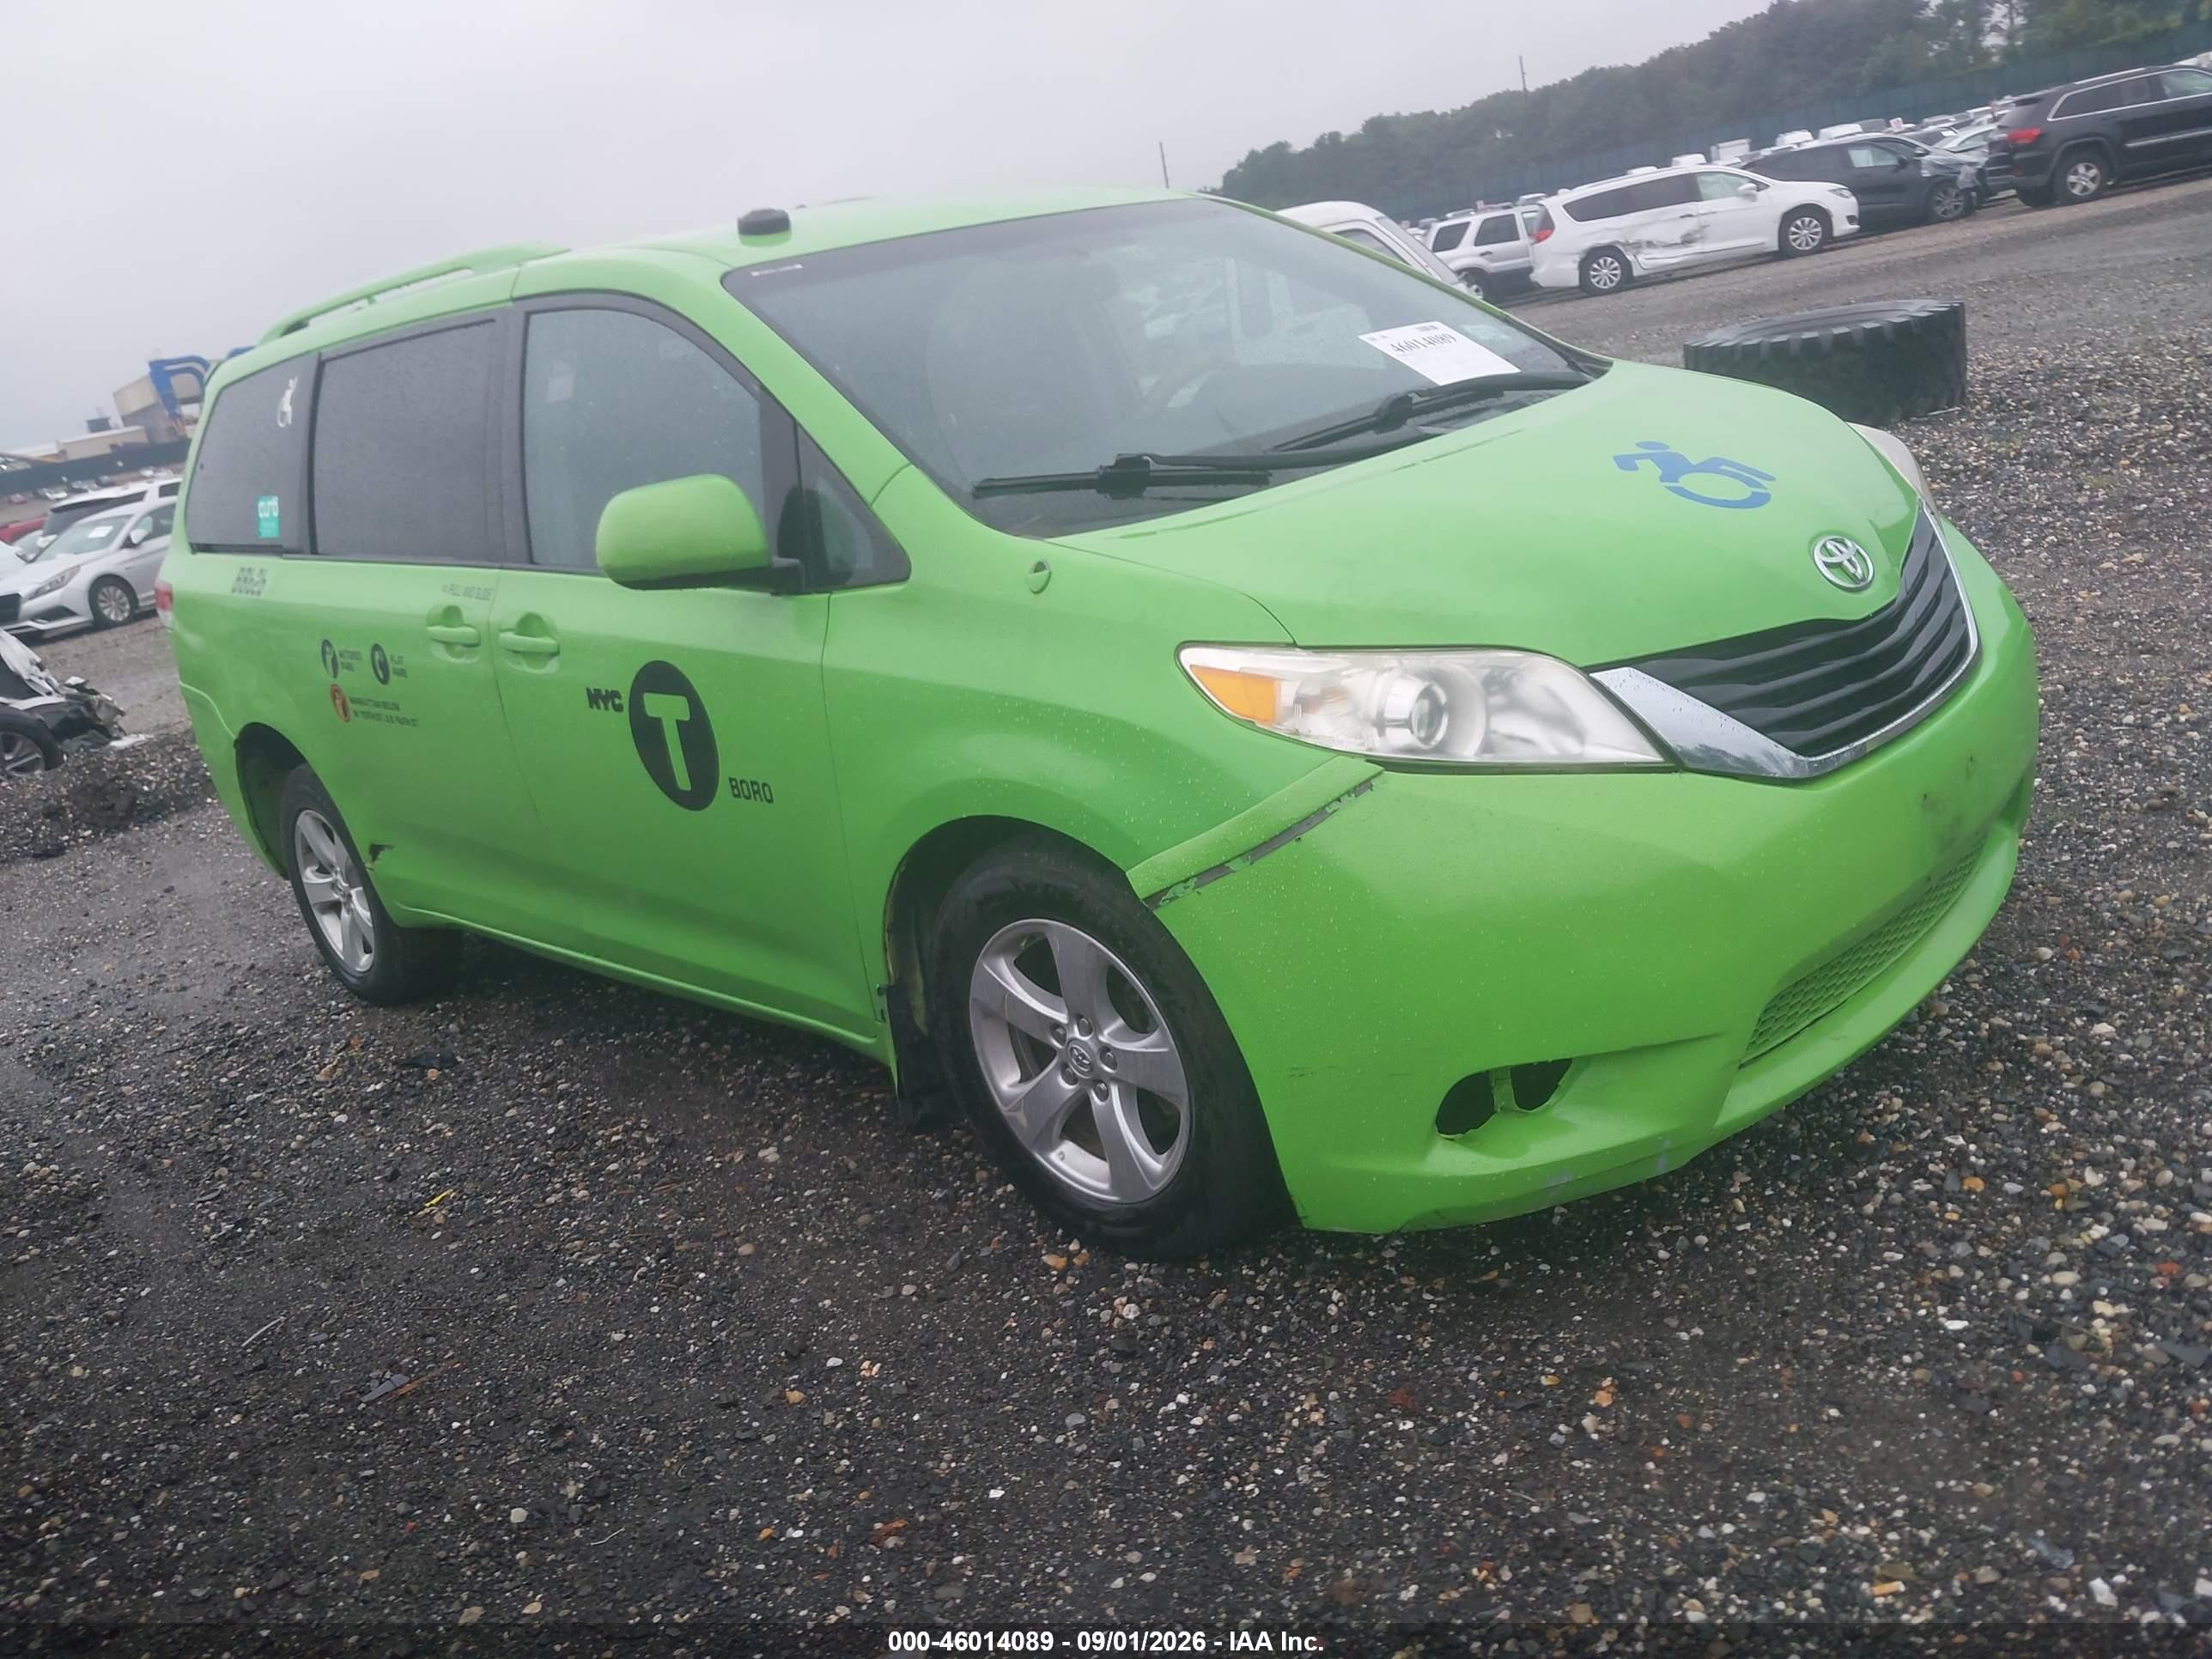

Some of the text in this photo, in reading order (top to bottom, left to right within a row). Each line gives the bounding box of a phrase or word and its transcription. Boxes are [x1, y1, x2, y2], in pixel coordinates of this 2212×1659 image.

[1390, 333, 1457, 352] 46014089
[586, 687, 624, 713] NYC
[643, 692, 691, 792] T
[728, 776, 775, 804] BORO
